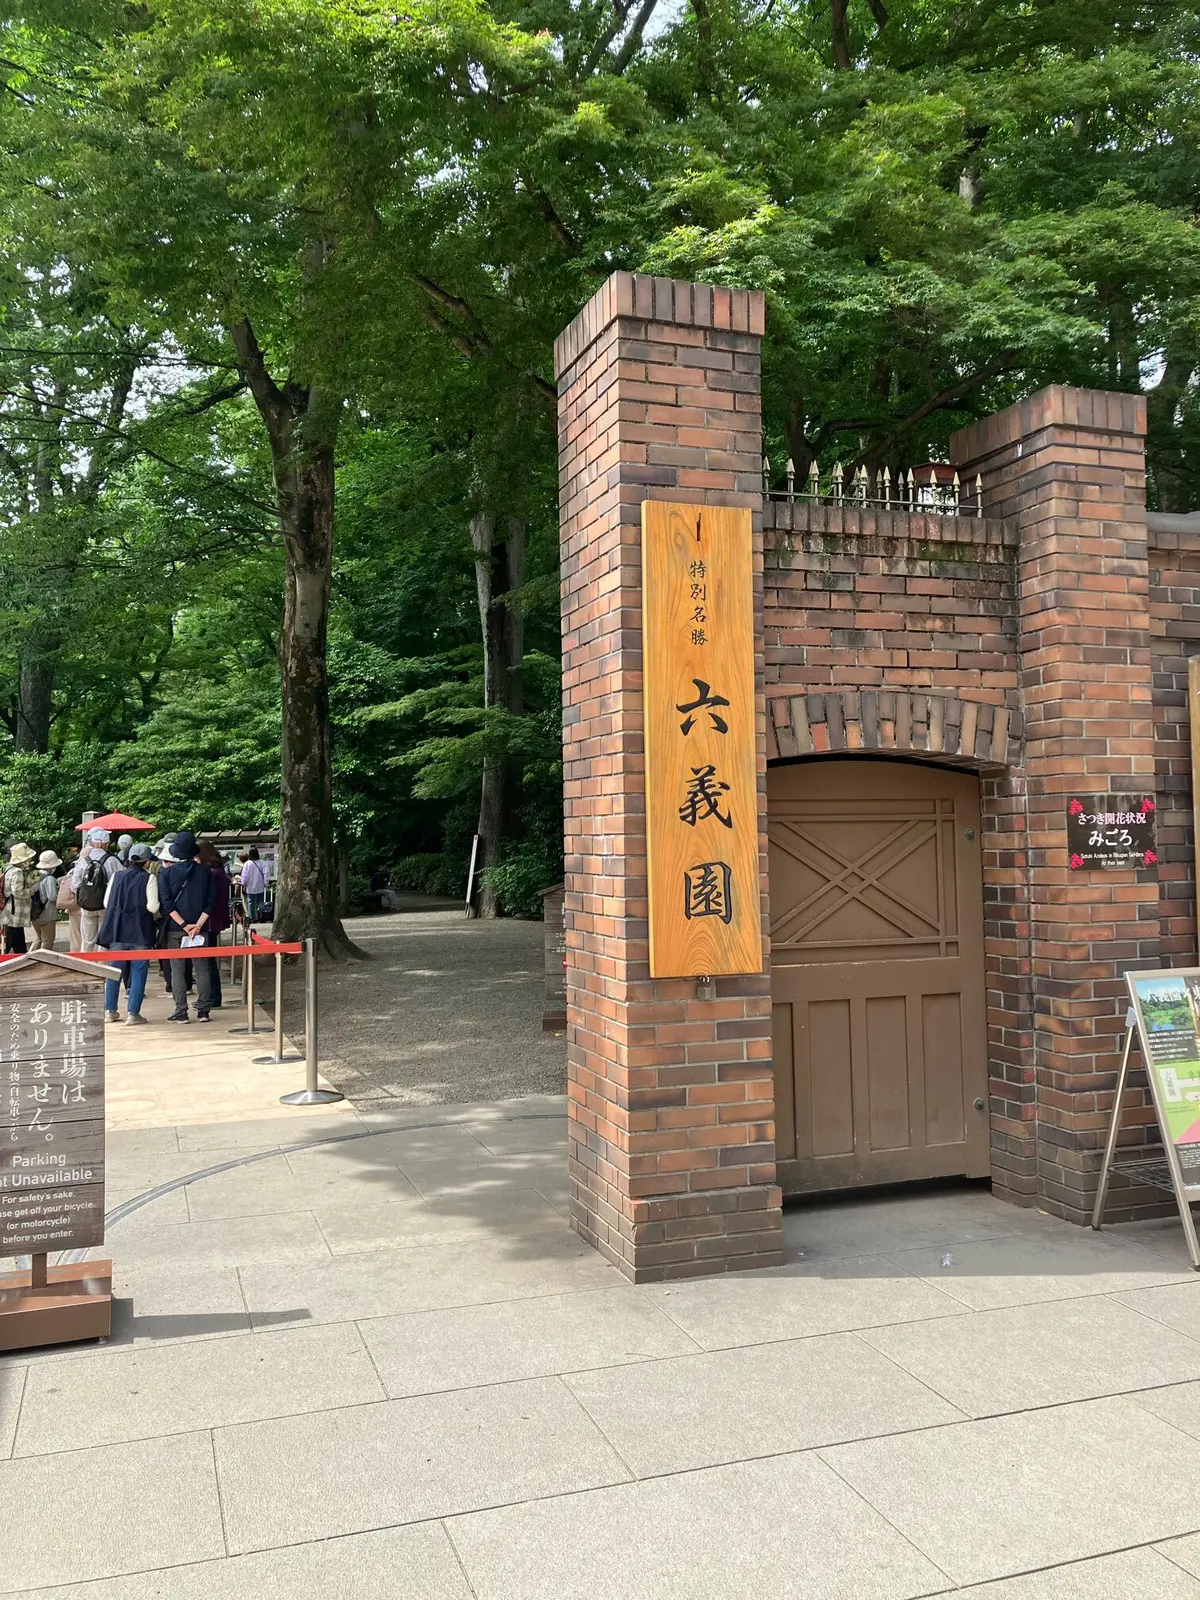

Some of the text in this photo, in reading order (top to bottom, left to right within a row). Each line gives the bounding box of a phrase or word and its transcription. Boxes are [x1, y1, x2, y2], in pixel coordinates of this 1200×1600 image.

[689, 559, 708, 647] 特別名勝
[676, 678, 733, 925] 六義園
[1078, 812, 1147, 825] さつき開花状況
[1088, 828, 1132, 847] みごろ
[60, 999, 88, 1105] 駐車場は
[27, 1002, 54, 1141] ありません。
[12, 1152, 67, 1168] Parking
[12, 1167, 93, 1187] Unavailable
[2, 1196, 18, 1204] For
[18, 1192, 51, 1203] safety's
[14, 1207, 29, 1218] get
[30, 1205, 42, 1215] off
[43, 1204, 62, 1215] your
[64, 1201, 93, 1212] bicycle
[6, 1216, 71, 1231] (or motorcycle)
[3, 1229, 74, 1244] before you enter.
